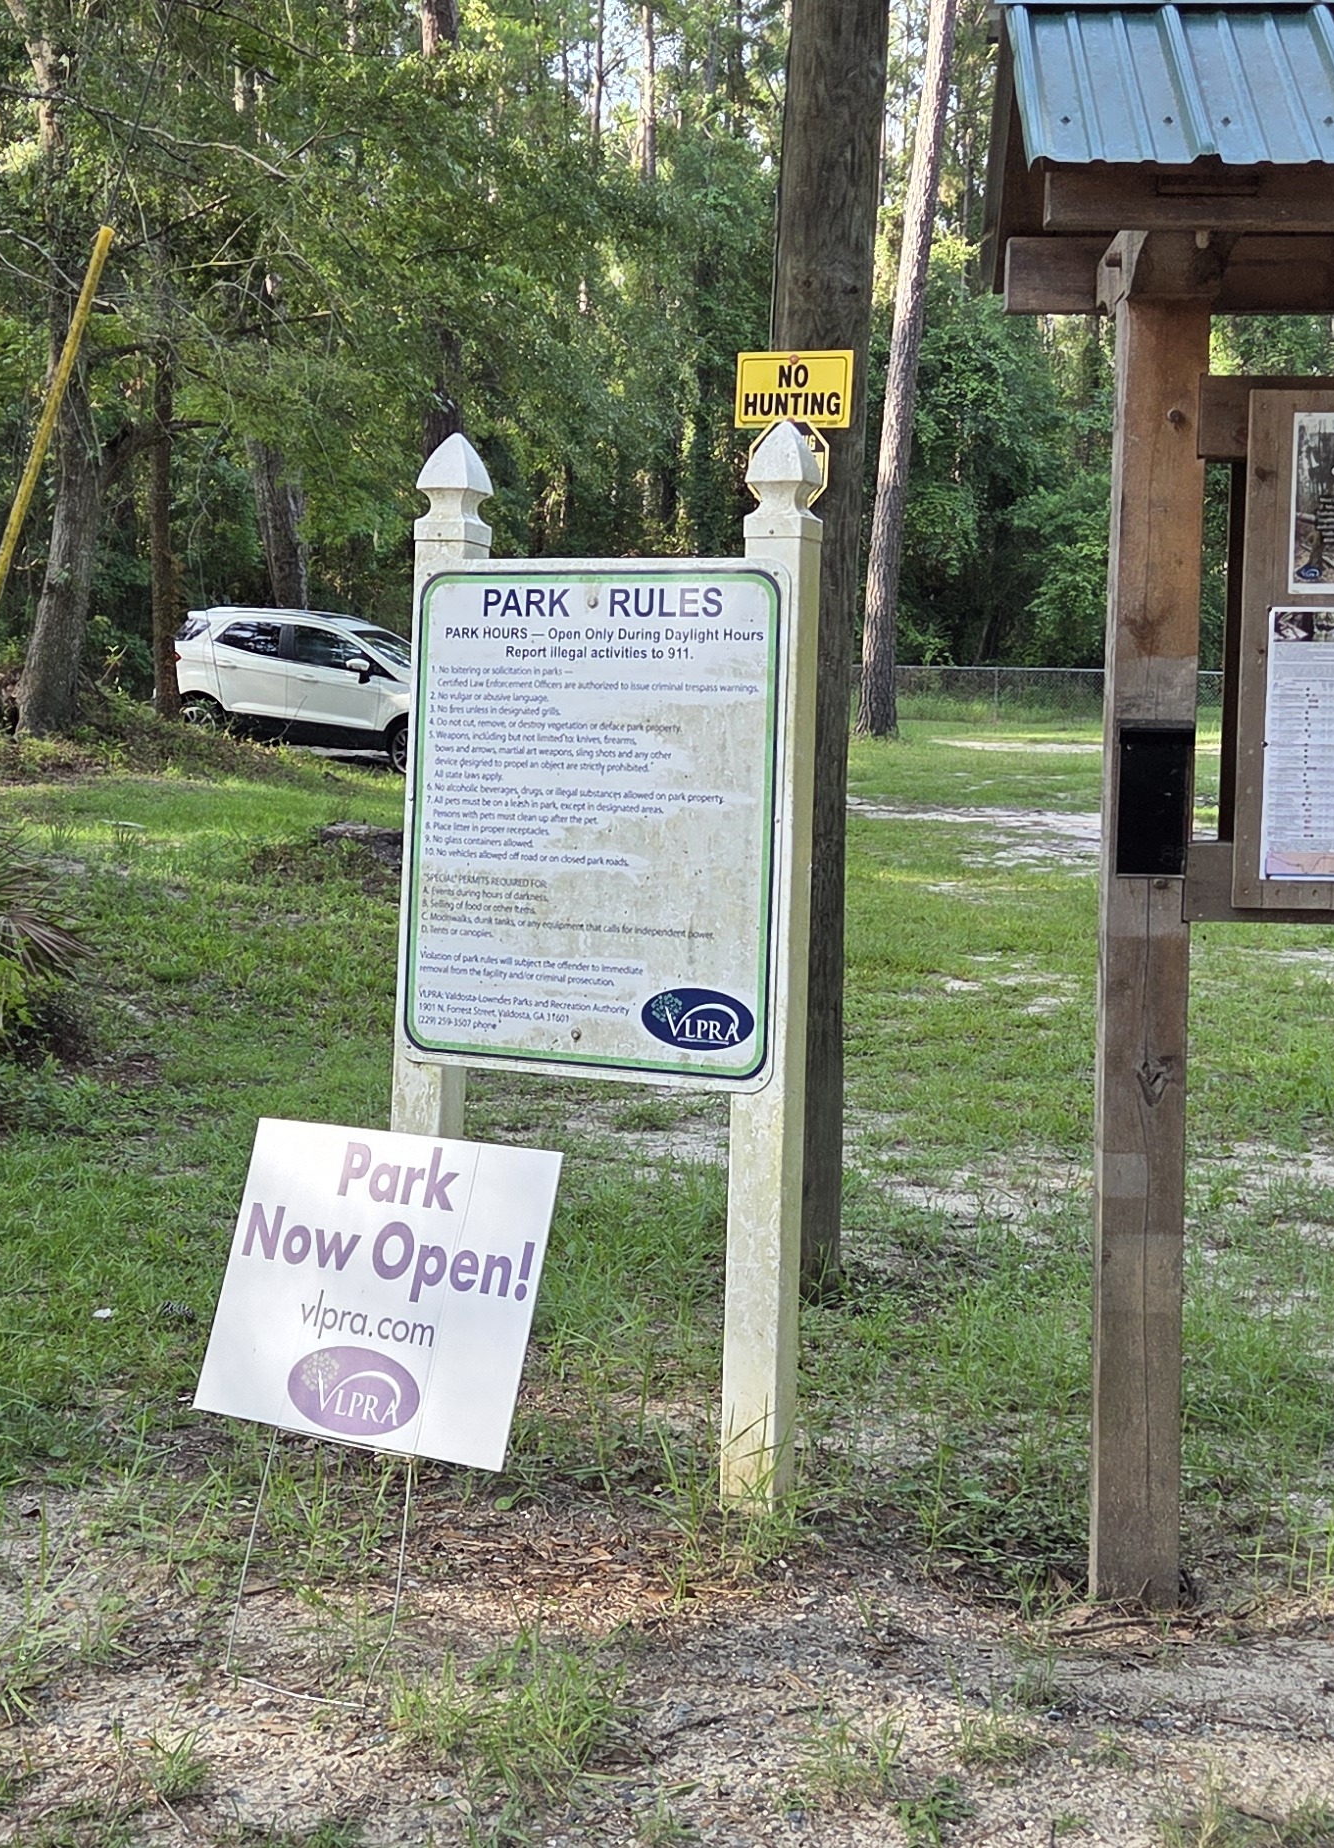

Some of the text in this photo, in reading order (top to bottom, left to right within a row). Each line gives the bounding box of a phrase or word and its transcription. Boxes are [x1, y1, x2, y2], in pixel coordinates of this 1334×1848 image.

[778, 365, 808, 388] NO
[744, 392, 841, 416] HUNTING
[483, 587, 723, 618] PARK RULES
[445, 627, 479, 639] PARK
[483, 627, 528, 639] HOURS
[548, 628, 580, 642] Open
[585, 628, 613, 642] Only
[618, 628, 660, 643] During
[665, 628, 719, 643] Daylight
[724, 629, 764, 641] Hours
[506, 646, 694, 660] Report illegal activities to 911.
[492, 666, 532, 675] solicitation
[534, 667, 541, 675] in
[543, 667, 562, 676] parks
[437, 679, 467, 687] Certified
[486, 680, 532, 688] Enforcement
[534, 680, 562, 689] Officers
[578, 680, 618, 690] authorized
[620, 682, 629, 690] to
[631, 682, 649, 690] issue
[652, 682, 683, 691] criminal
[685, 683, 717, 693] trespass
[450, 692, 472, 702] vulgar
[483, 693, 511, 701] abusive
[499, 706, 539, 717] designated
[437, 718, 447, 726] Do
[518, 721, 545, 730] destroy
[548, 721, 587, 732] vegetation
[627, 722, 644, 732] park
[508, 732, 520, 741] but
[456, 745, 469, 753] and
[595, 749, 616, 758] shots
[618, 750, 632, 759] and
[635, 751, 648, 760] any
[651, 751, 671, 759] other
[435, 757, 458, 766] device
[541, 760, 564, 770] object
[434, 770, 479, 779] All state laws
[435, 783, 445, 791] No
[447, 783, 478, 793] alcoholic
[580, 788, 621, 798] substances
[623, 790, 654, 800] allowed
[668, 792, 686, 802] park
[434, 795, 444, 804] All
[462, 797, 480, 805] must
[596, 803, 639, 813] designated
[570, 815, 582, 824] the
[433, 835, 443, 843] No
[445, 836, 462, 846] glass
[587, 855, 603, 866] park
[534, 999, 549, 1007] and
[533, 1011, 544, 1020] GA
[665, 1005, 740, 1041] VLPRA
[337, 1141, 460, 1212] Park
[241, 1202, 536, 1303] Now Open!
[300, 1289, 435, 1347] vlpra.com
[316, 1369, 402, 1427] VLPRA
